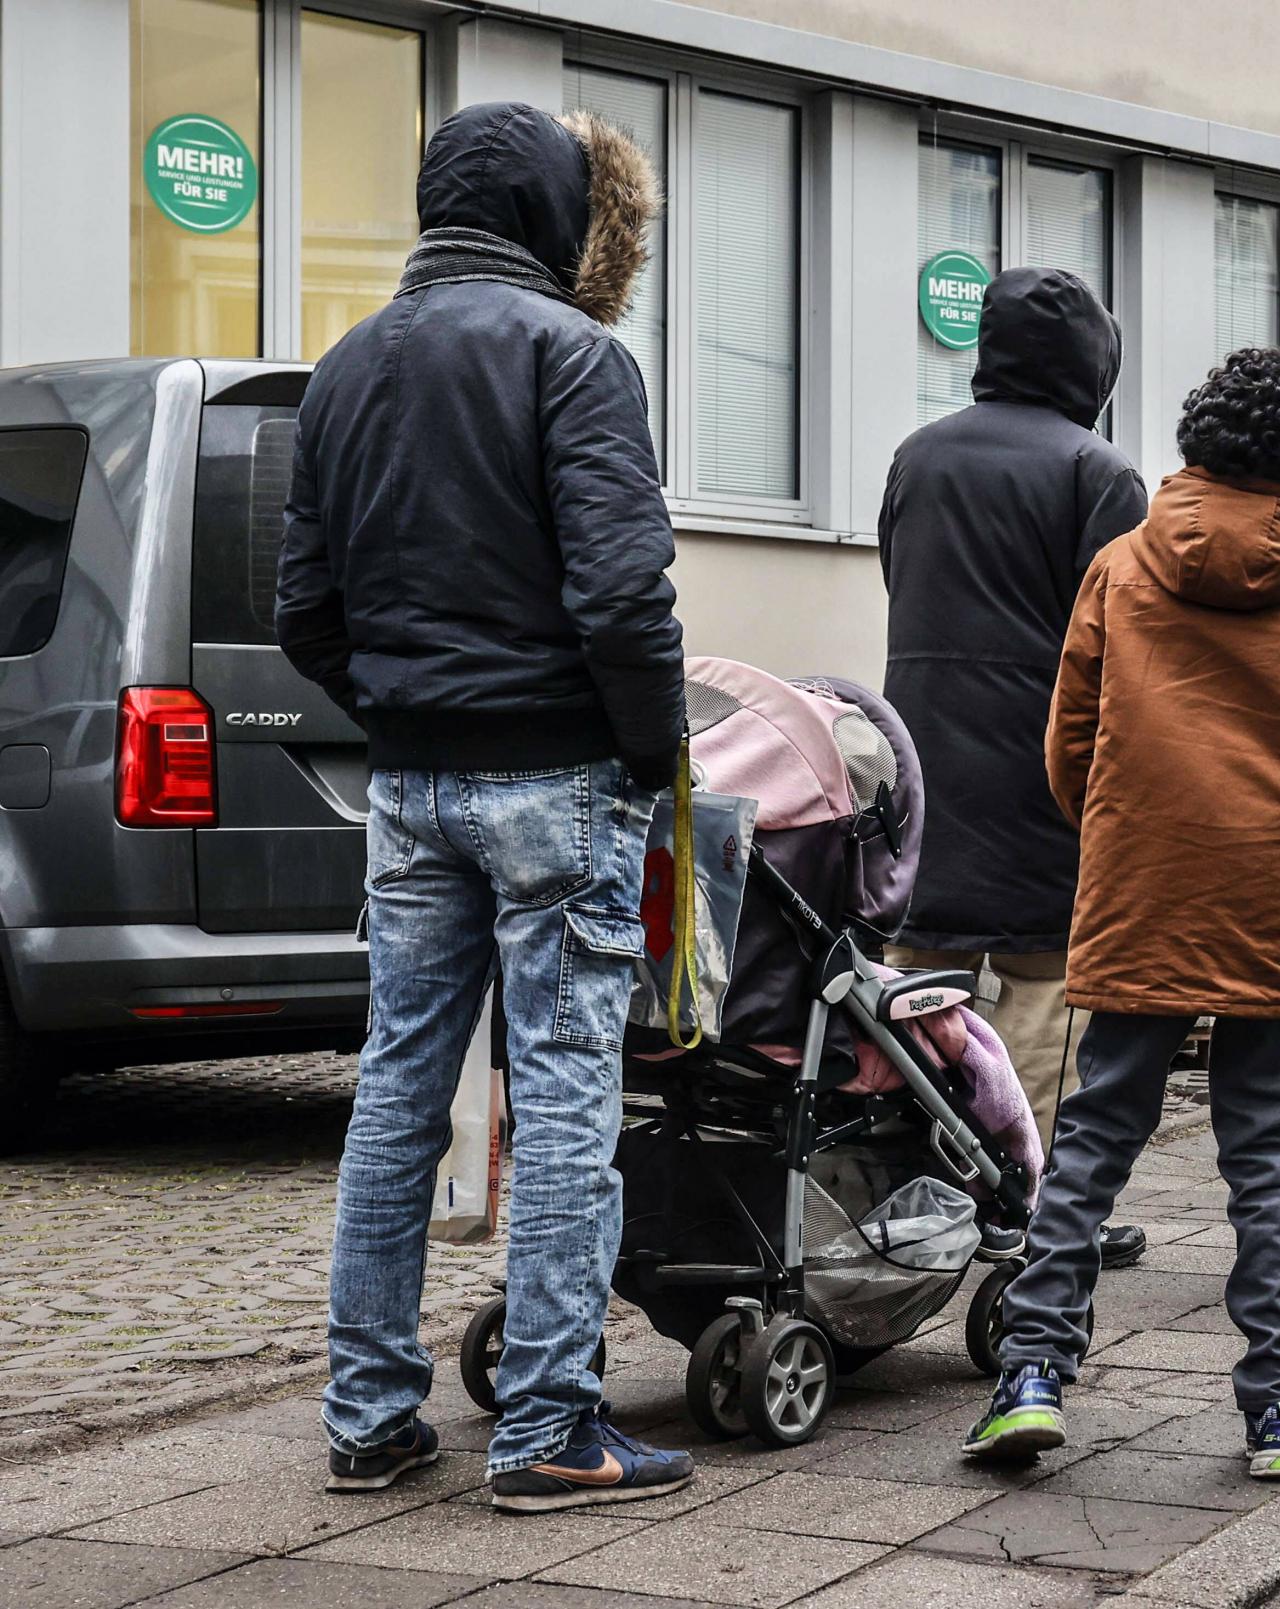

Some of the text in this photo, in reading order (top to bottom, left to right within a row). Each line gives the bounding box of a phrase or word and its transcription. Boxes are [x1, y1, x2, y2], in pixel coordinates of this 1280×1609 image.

[157, 144, 244, 179] MEHR!
[173, 181, 228, 202] FÜR SIE
[940, 306, 978, 322] FÜR SIE
[225, 712, 303, 726] CADDY
